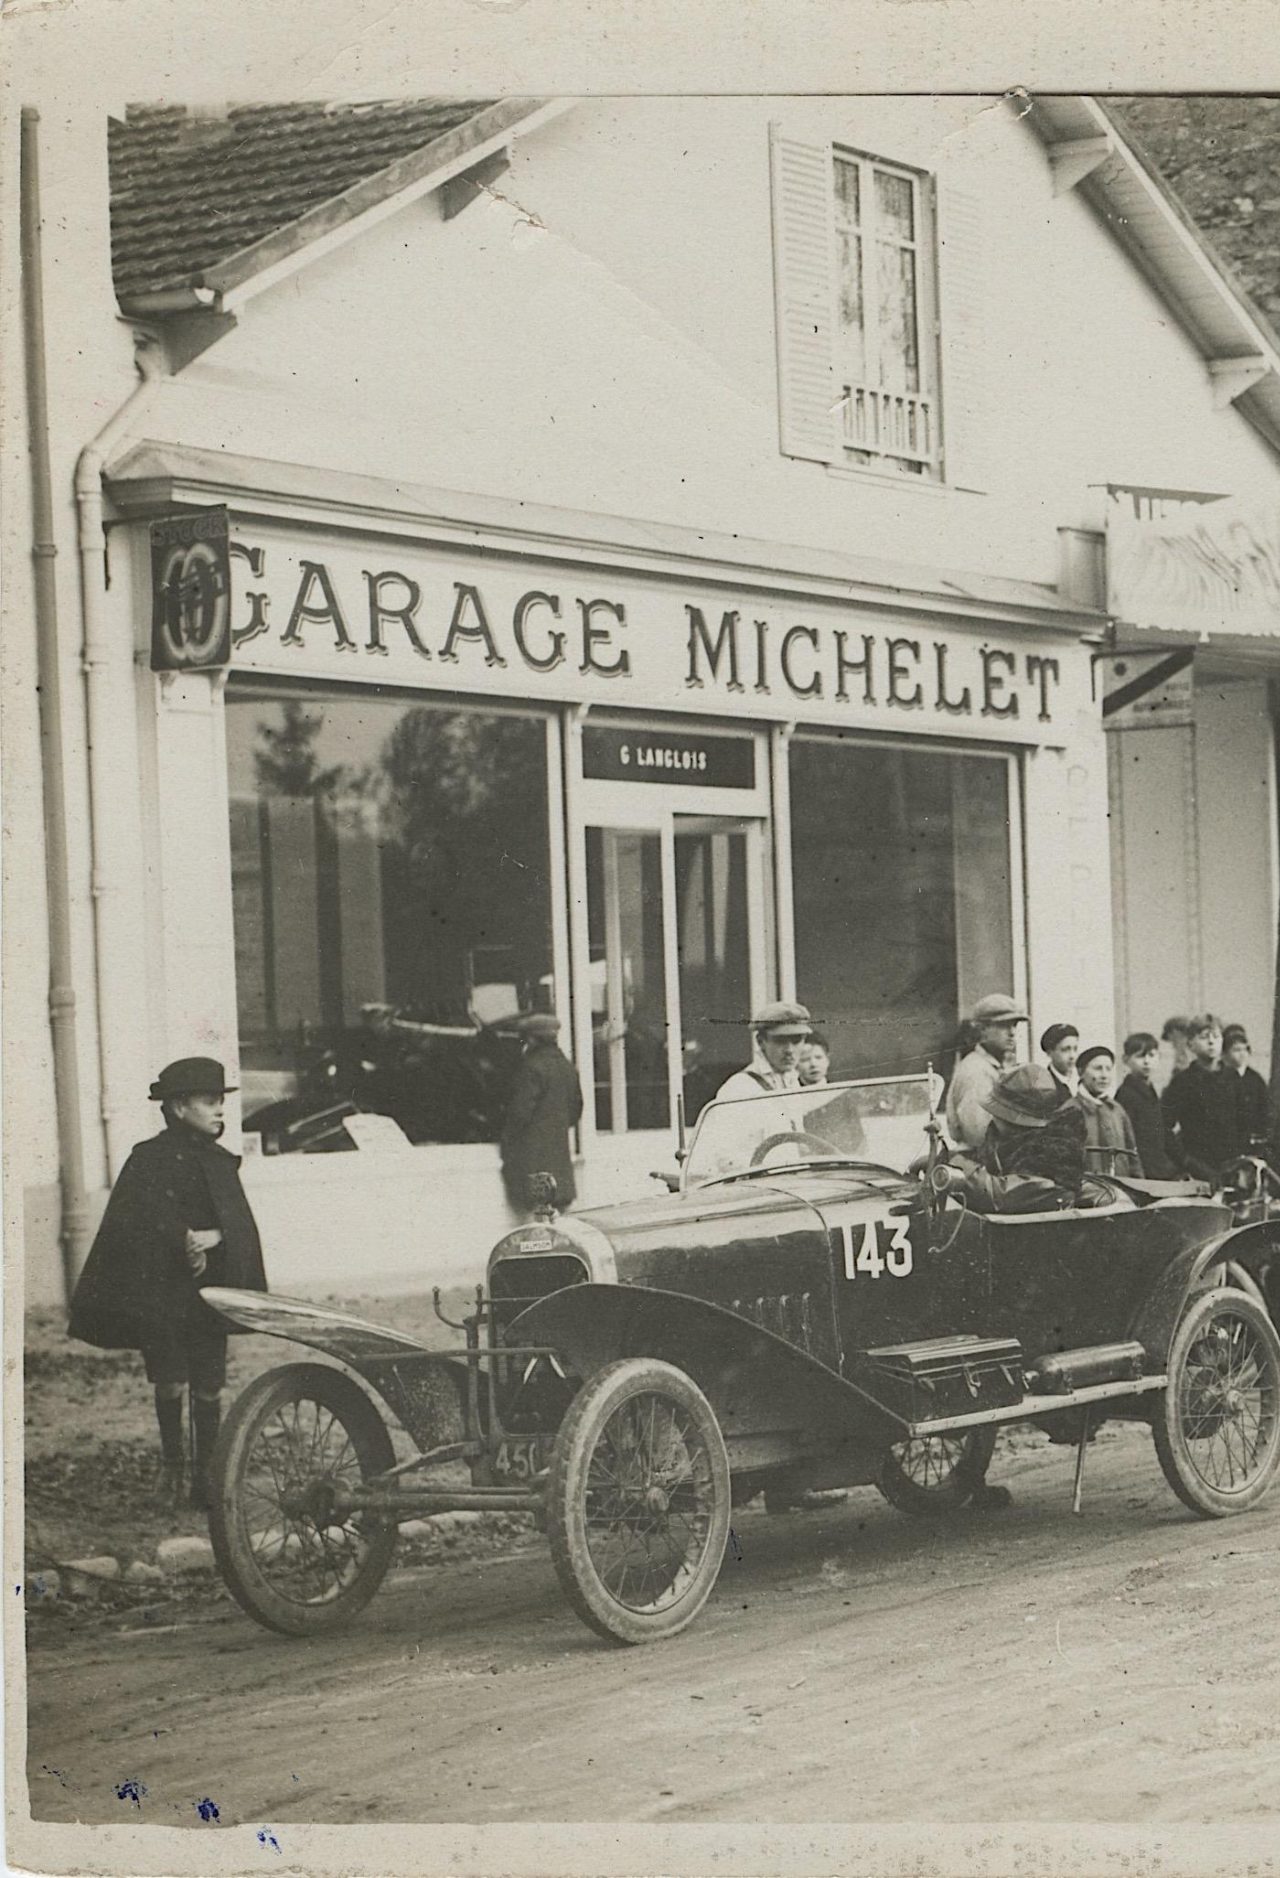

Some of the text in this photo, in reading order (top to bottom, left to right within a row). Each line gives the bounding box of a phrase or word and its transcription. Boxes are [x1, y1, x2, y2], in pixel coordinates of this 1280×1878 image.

[230, 541, 1060, 723] GARAGE MICHELET
[636, 746, 707, 770] LANGLOIS
[841, 1214, 913, 1279] 143
